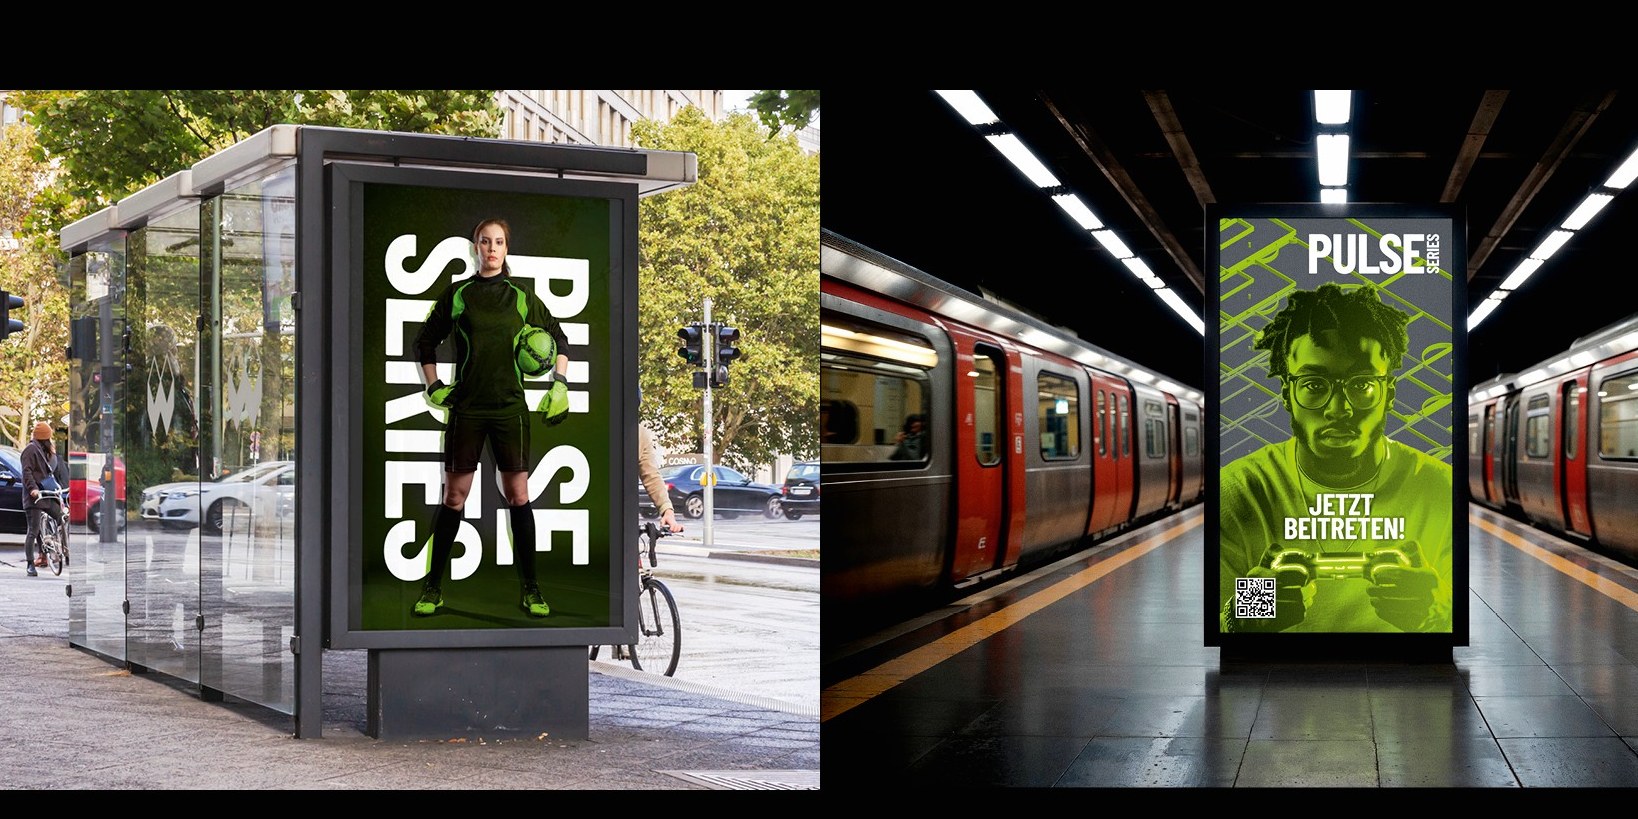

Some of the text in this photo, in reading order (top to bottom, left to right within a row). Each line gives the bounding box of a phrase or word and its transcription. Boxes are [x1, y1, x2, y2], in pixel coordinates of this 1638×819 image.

[1308, 233, 1425, 275] PULSE
[1426, 233, 1440, 275] SERIES
[1309, 493, 1375, 516] JETZT
[1284, 517, 1405, 540] BEITRETEN!
